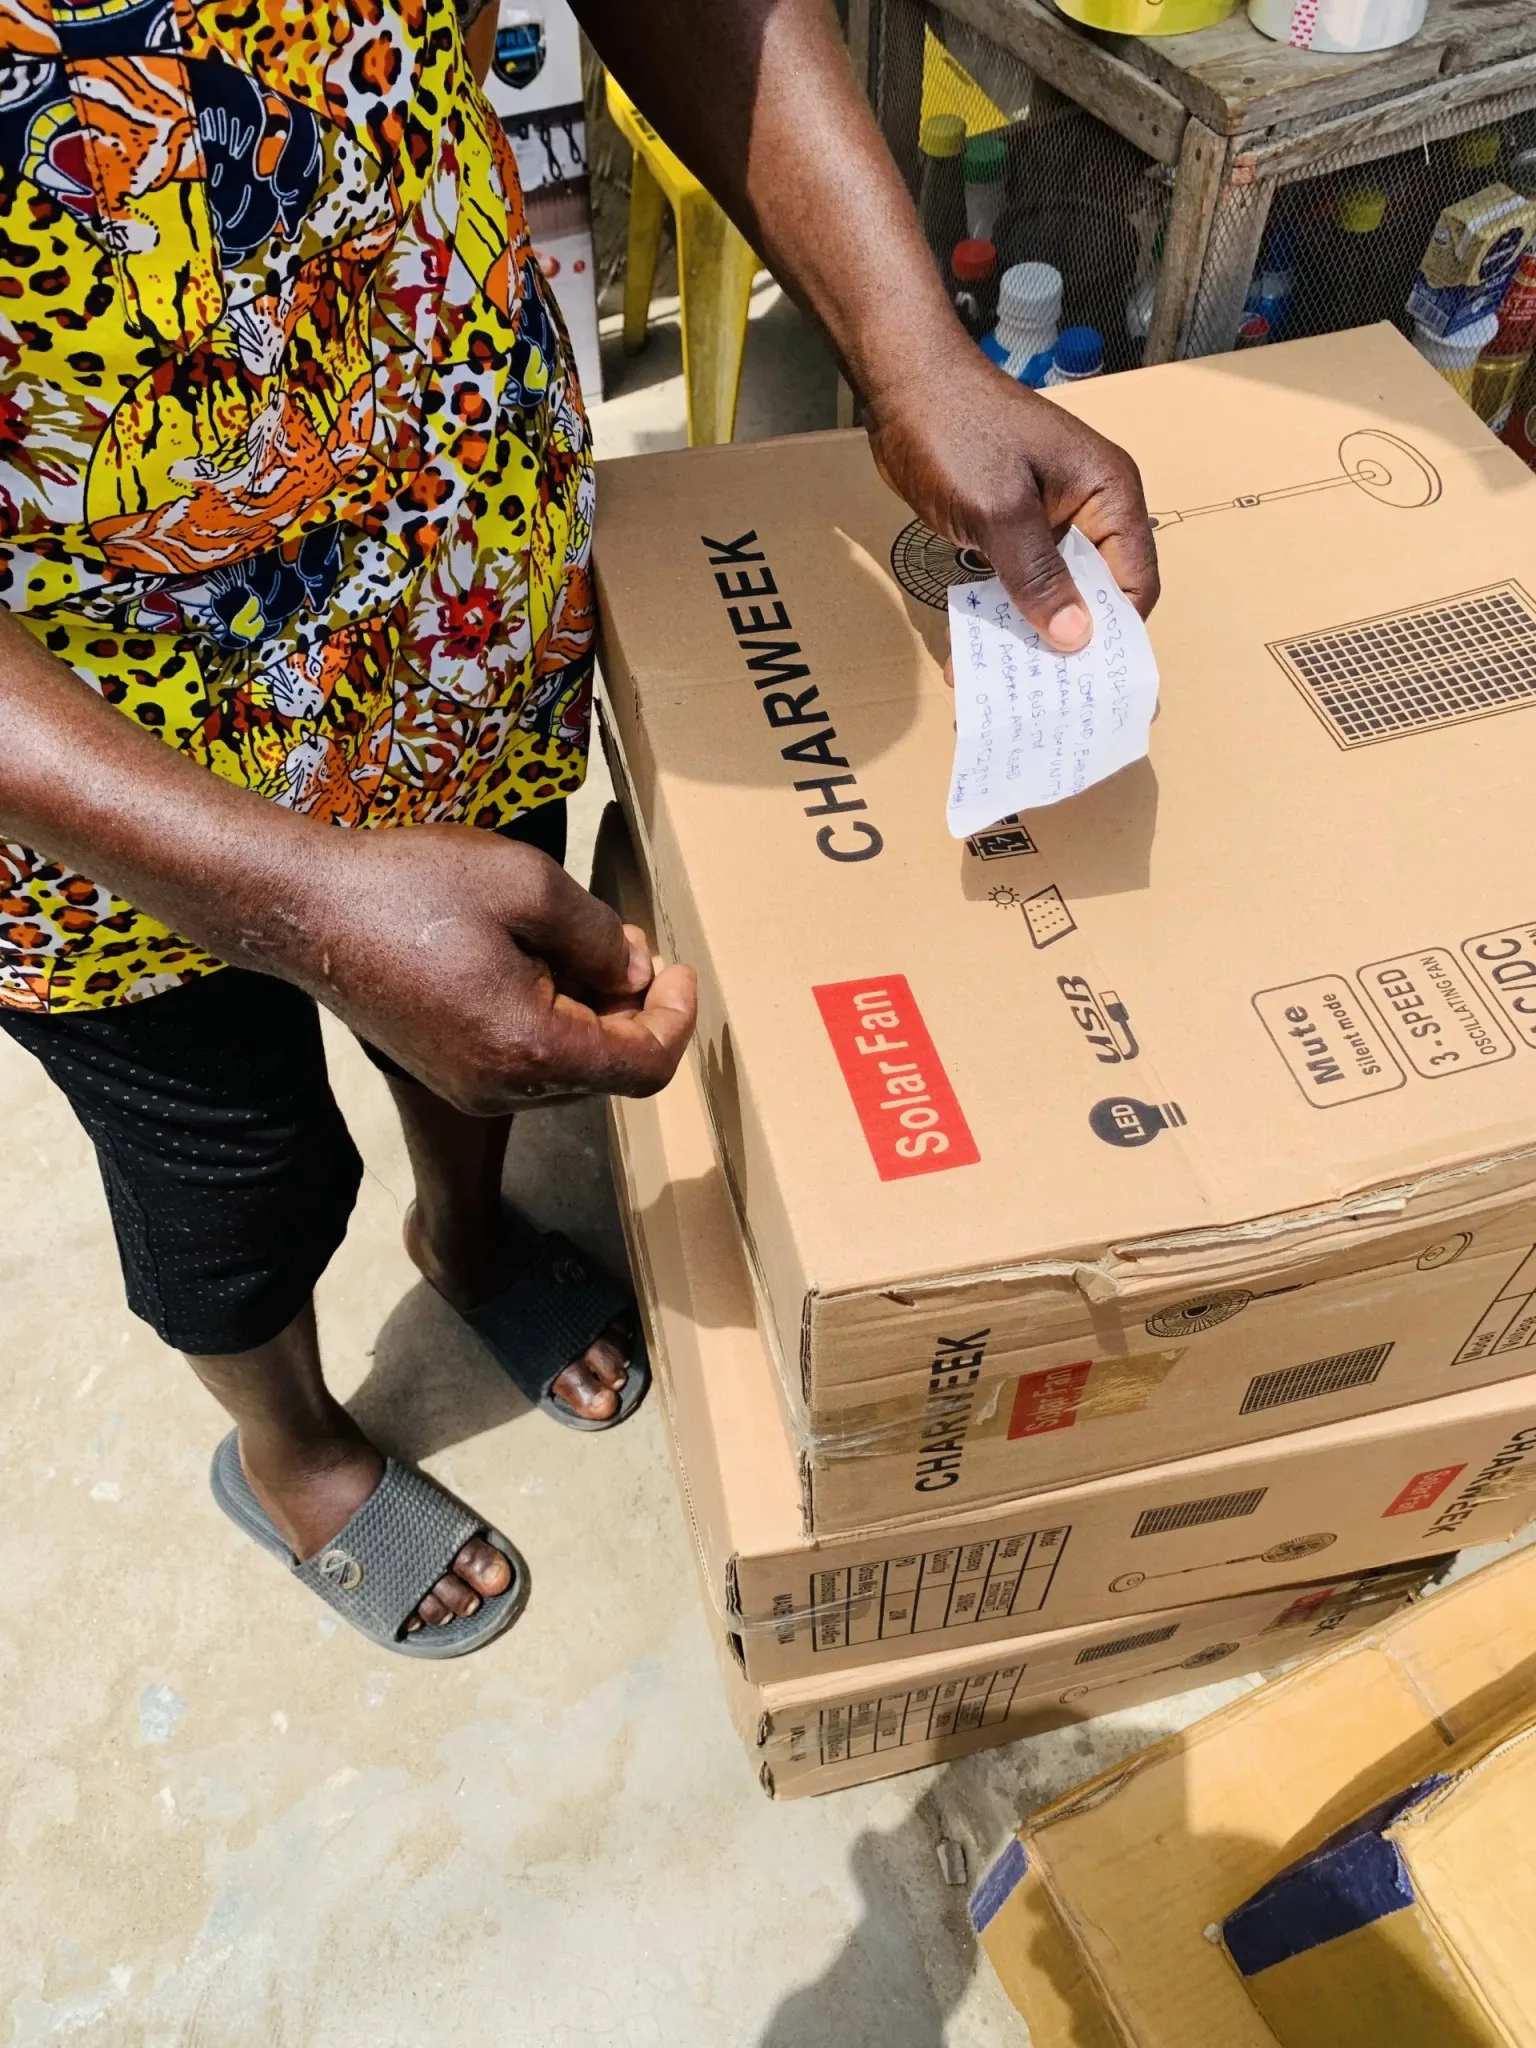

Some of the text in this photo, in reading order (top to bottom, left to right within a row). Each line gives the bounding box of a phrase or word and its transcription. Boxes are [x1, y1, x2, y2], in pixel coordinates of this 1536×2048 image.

[701, 530, 883, 862] CHARWEEK
[1056, 975, 1122, 1063] USB
[1284, 1005, 1345, 1085] Mute
[1322, 993, 1382, 1076] Silent mode
[1419, 956, 1497, 1055] OSCILLATING FAN
[853, 990, 949, 1157] Solar Fan
[1111, 1104, 1145, 1139] LED
[1461, 1331, 1497, 1360] Model
[914, 1328, 991, 1492] CHARWEEK
